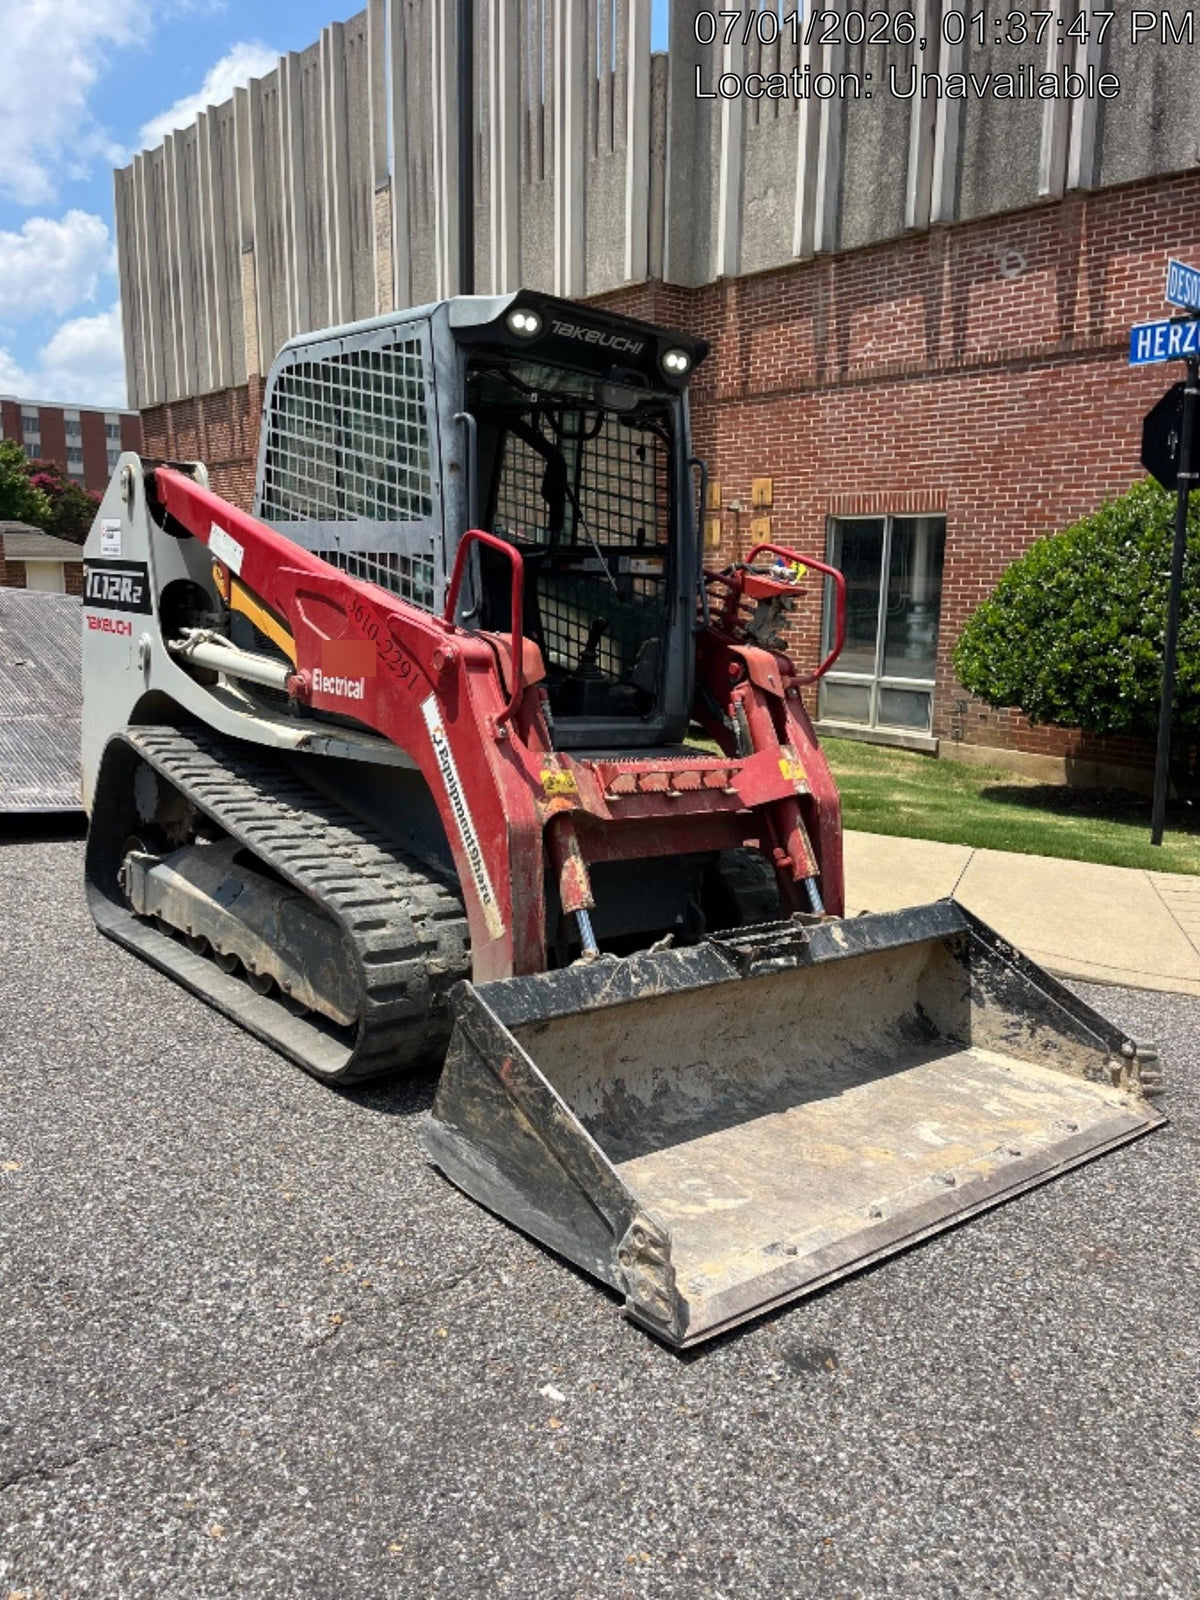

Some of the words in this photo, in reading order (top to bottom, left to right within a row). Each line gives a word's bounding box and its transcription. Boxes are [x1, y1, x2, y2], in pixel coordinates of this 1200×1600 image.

[1169, 265, 1200, 308] DESO
[551, 319, 644, 355] TAKEUCHI
[1137, 321, 1200, 359] HERZ
[312, 668, 365, 700] Electrical
